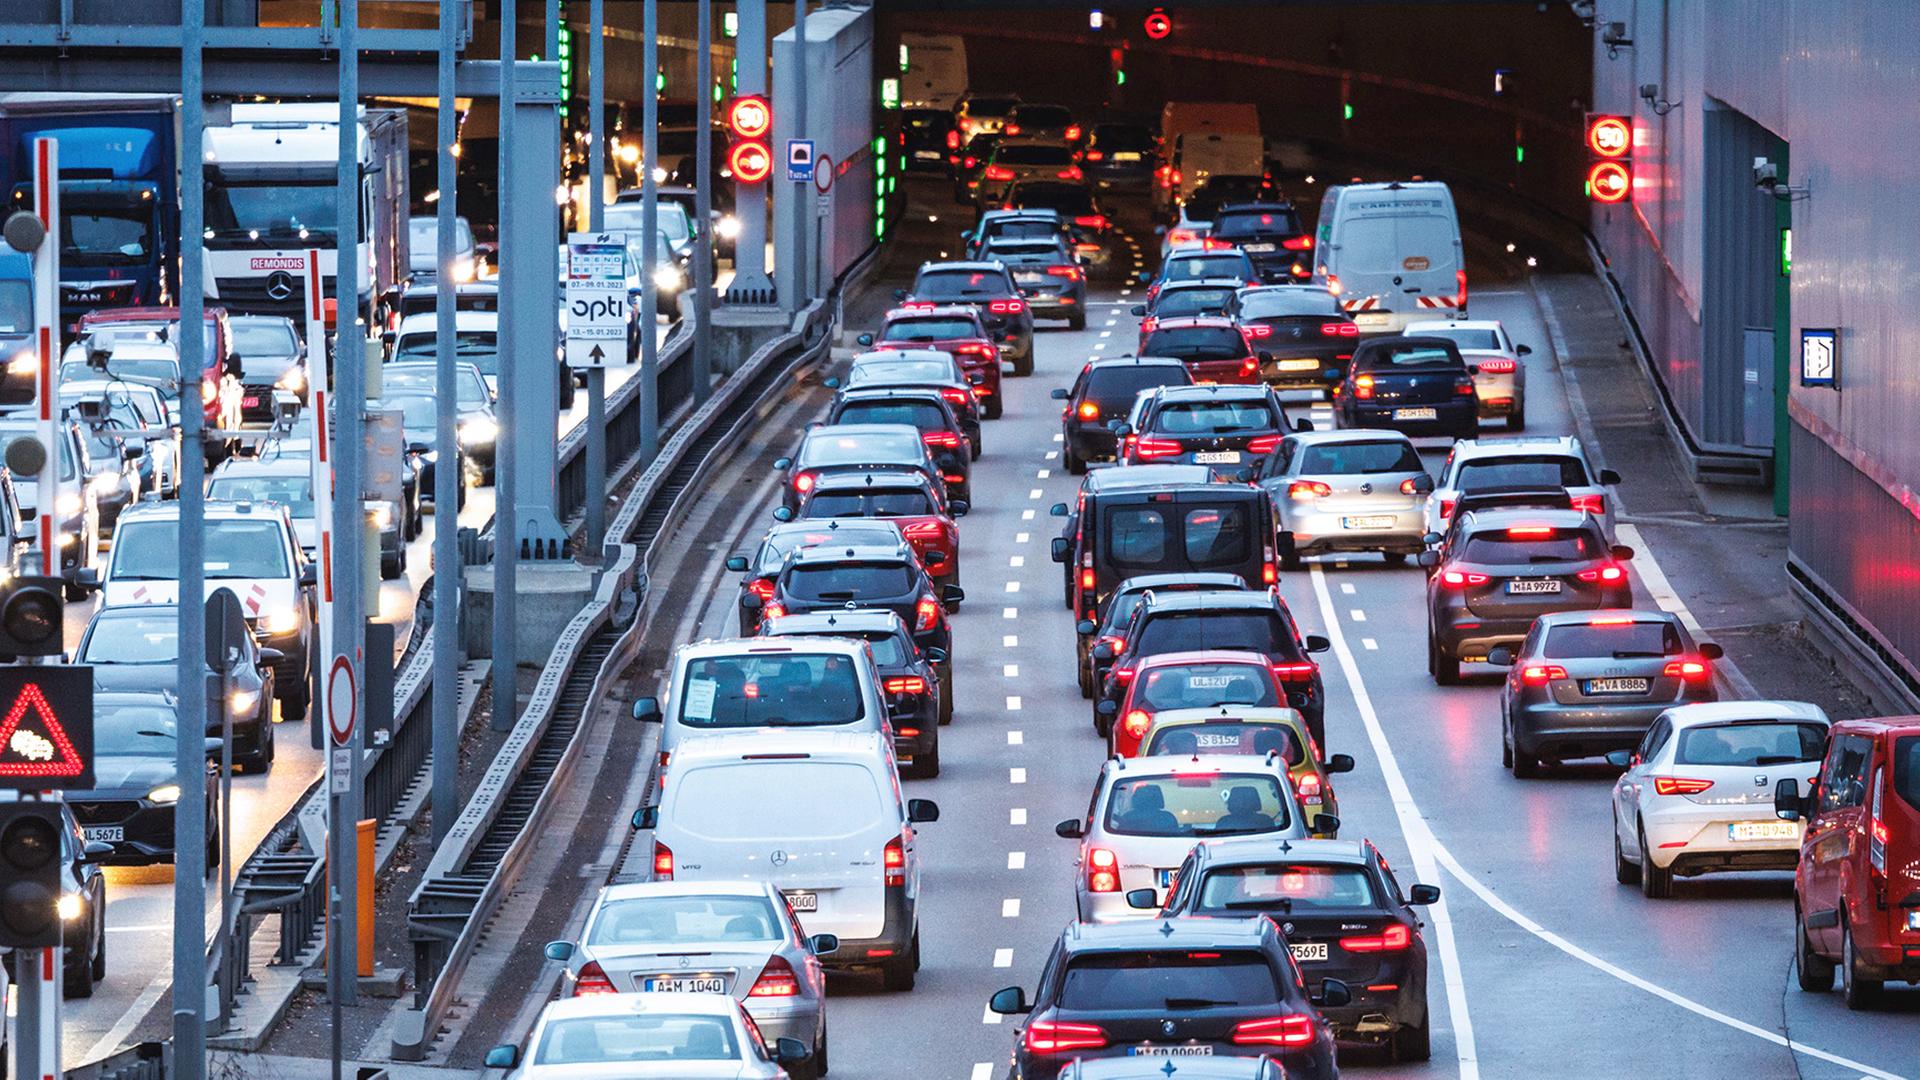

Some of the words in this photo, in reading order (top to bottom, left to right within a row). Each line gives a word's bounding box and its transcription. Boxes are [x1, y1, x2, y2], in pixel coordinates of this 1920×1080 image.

[1597, 126, 1624, 148] 50
[252, 258, 304, 269] REMONDIS
[68, 293, 102, 302] MAN
[572, 295, 623, 321] opti
[1534, 582, 1557, 591] 9972
[689, 980, 721, 992] 1040
